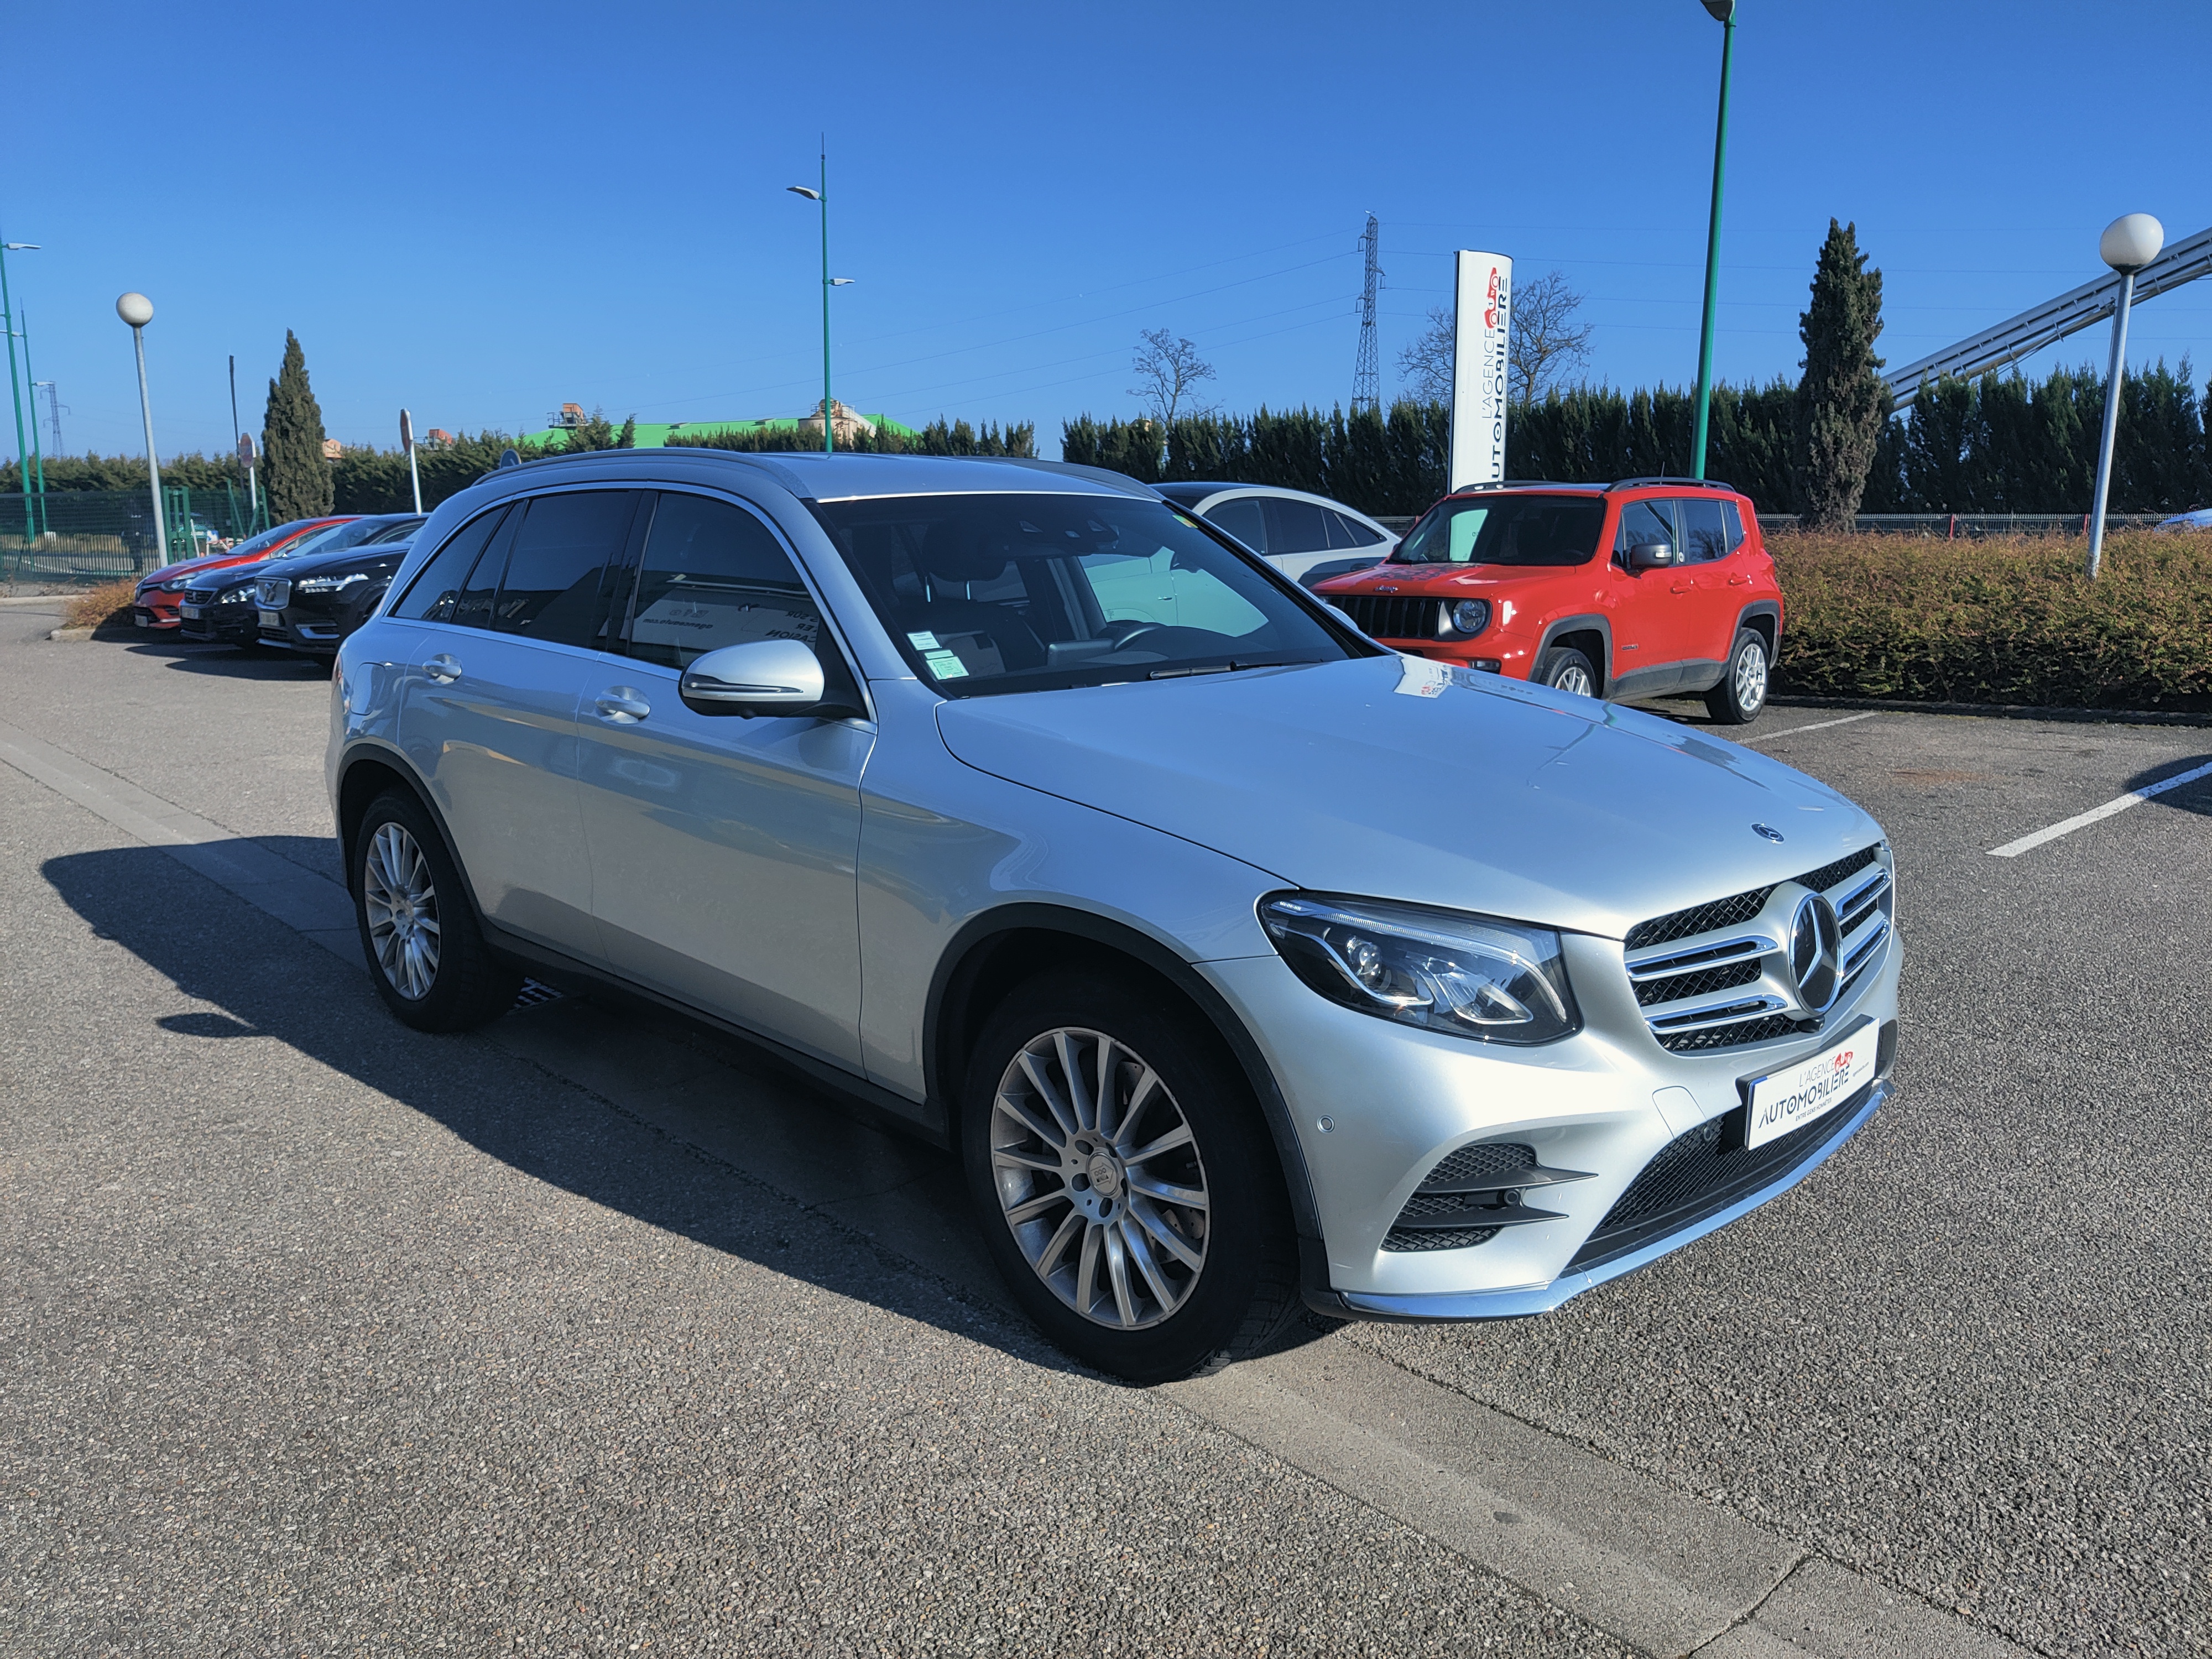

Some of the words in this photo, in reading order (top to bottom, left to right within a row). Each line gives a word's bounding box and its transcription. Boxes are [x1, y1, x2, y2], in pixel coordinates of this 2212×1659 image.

[1481, 328, 1495, 419] L'AGENCE
[1491, 276, 1507, 480] UTOMOBILIERE
[1759, 1064, 1850, 1129] AUTOMOBILIERE
[1799, 1056, 1836, 1087] L'AGENCE
